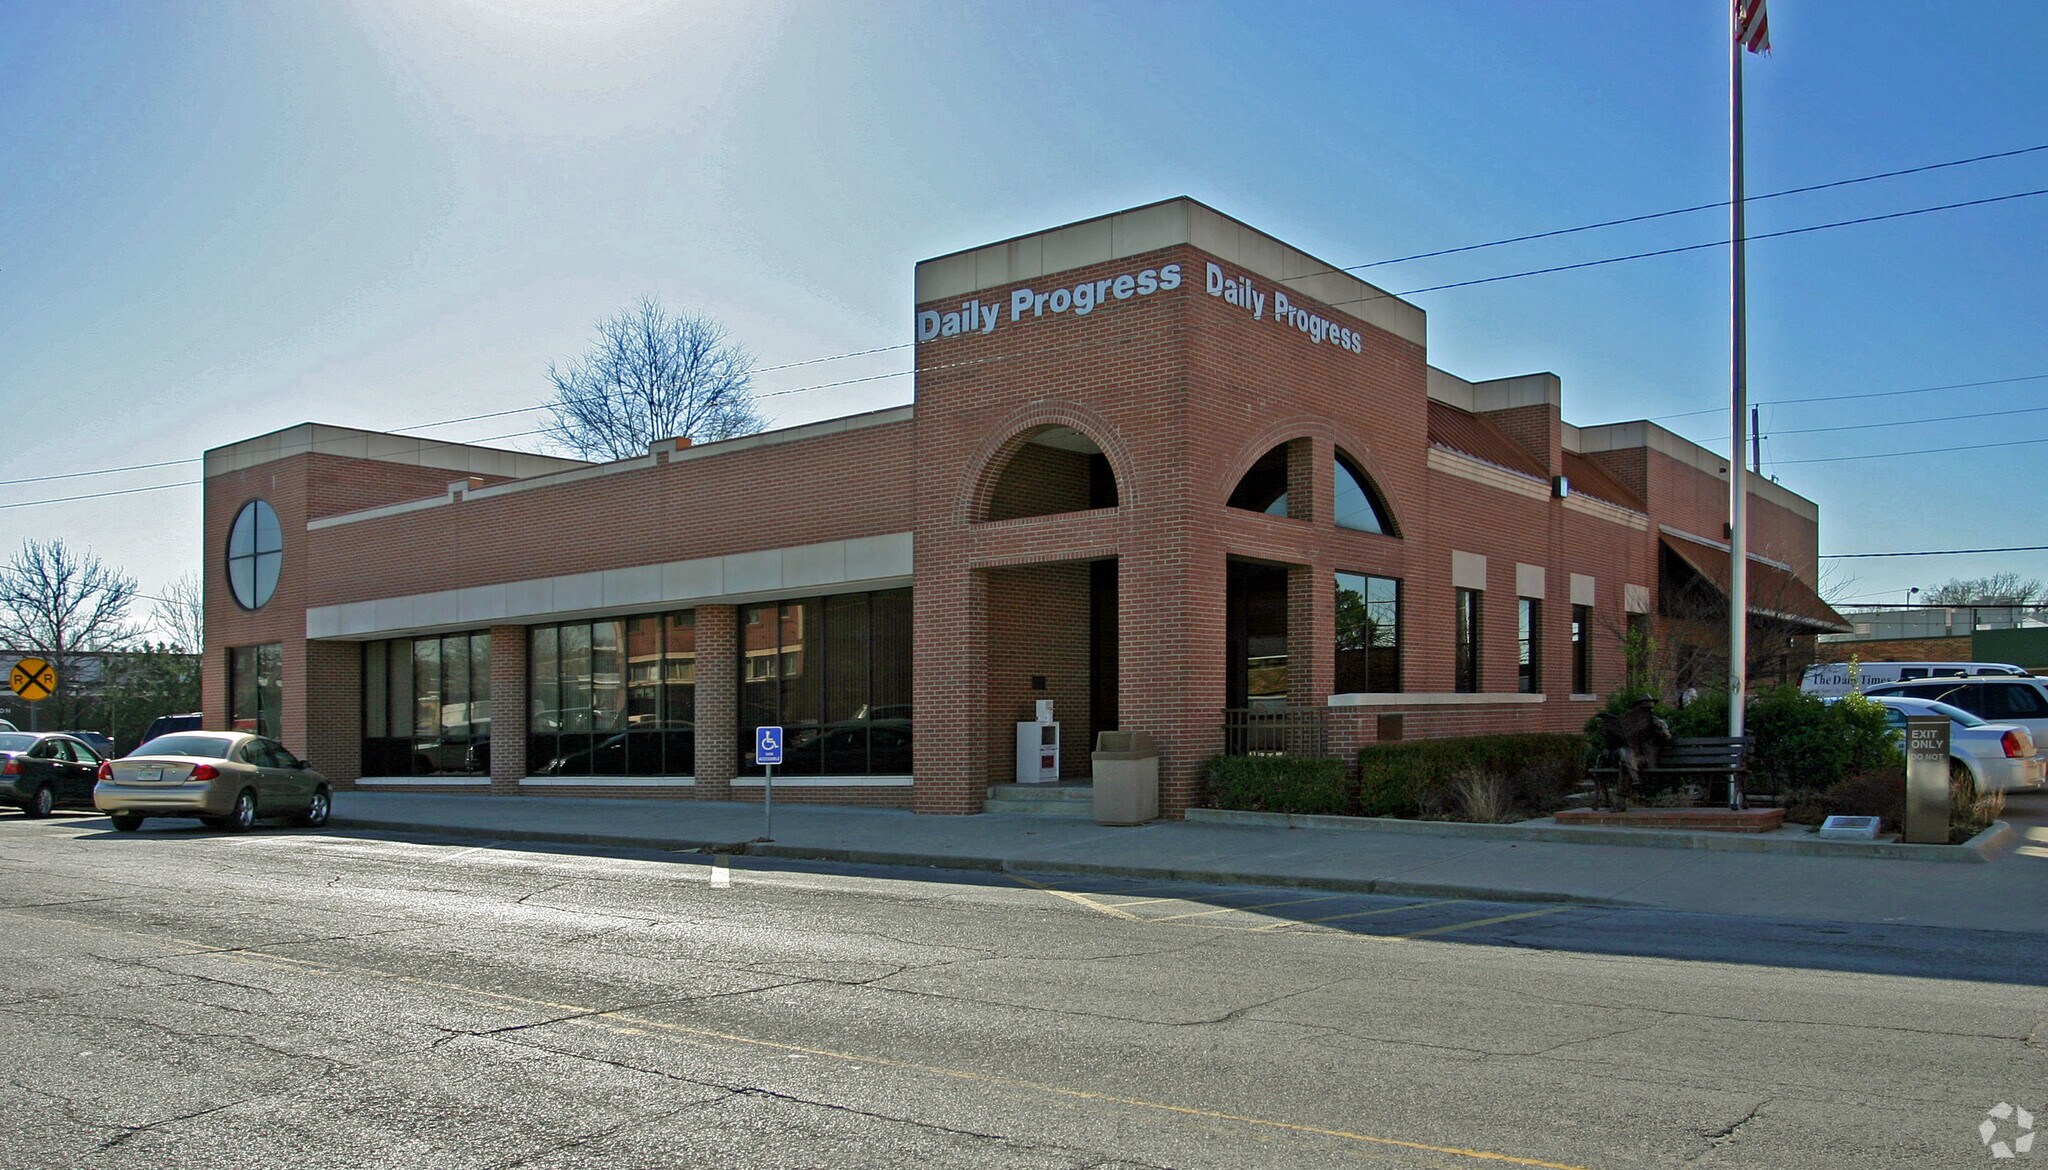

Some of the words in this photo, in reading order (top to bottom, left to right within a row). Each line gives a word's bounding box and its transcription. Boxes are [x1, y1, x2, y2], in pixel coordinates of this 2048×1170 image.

[918, 300, 1000, 341] Daily
[1011, 264, 1182, 321] Progress
[1206, 262, 1265, 320] Daily
[1275, 291, 1362, 354] Progress
[1813, 674, 1831, 685] The
[1833, 675, 1858, 687] Daiy
[1911, 730, 1938, 739] EXIT
[1911, 740, 1943, 749] ONLY
